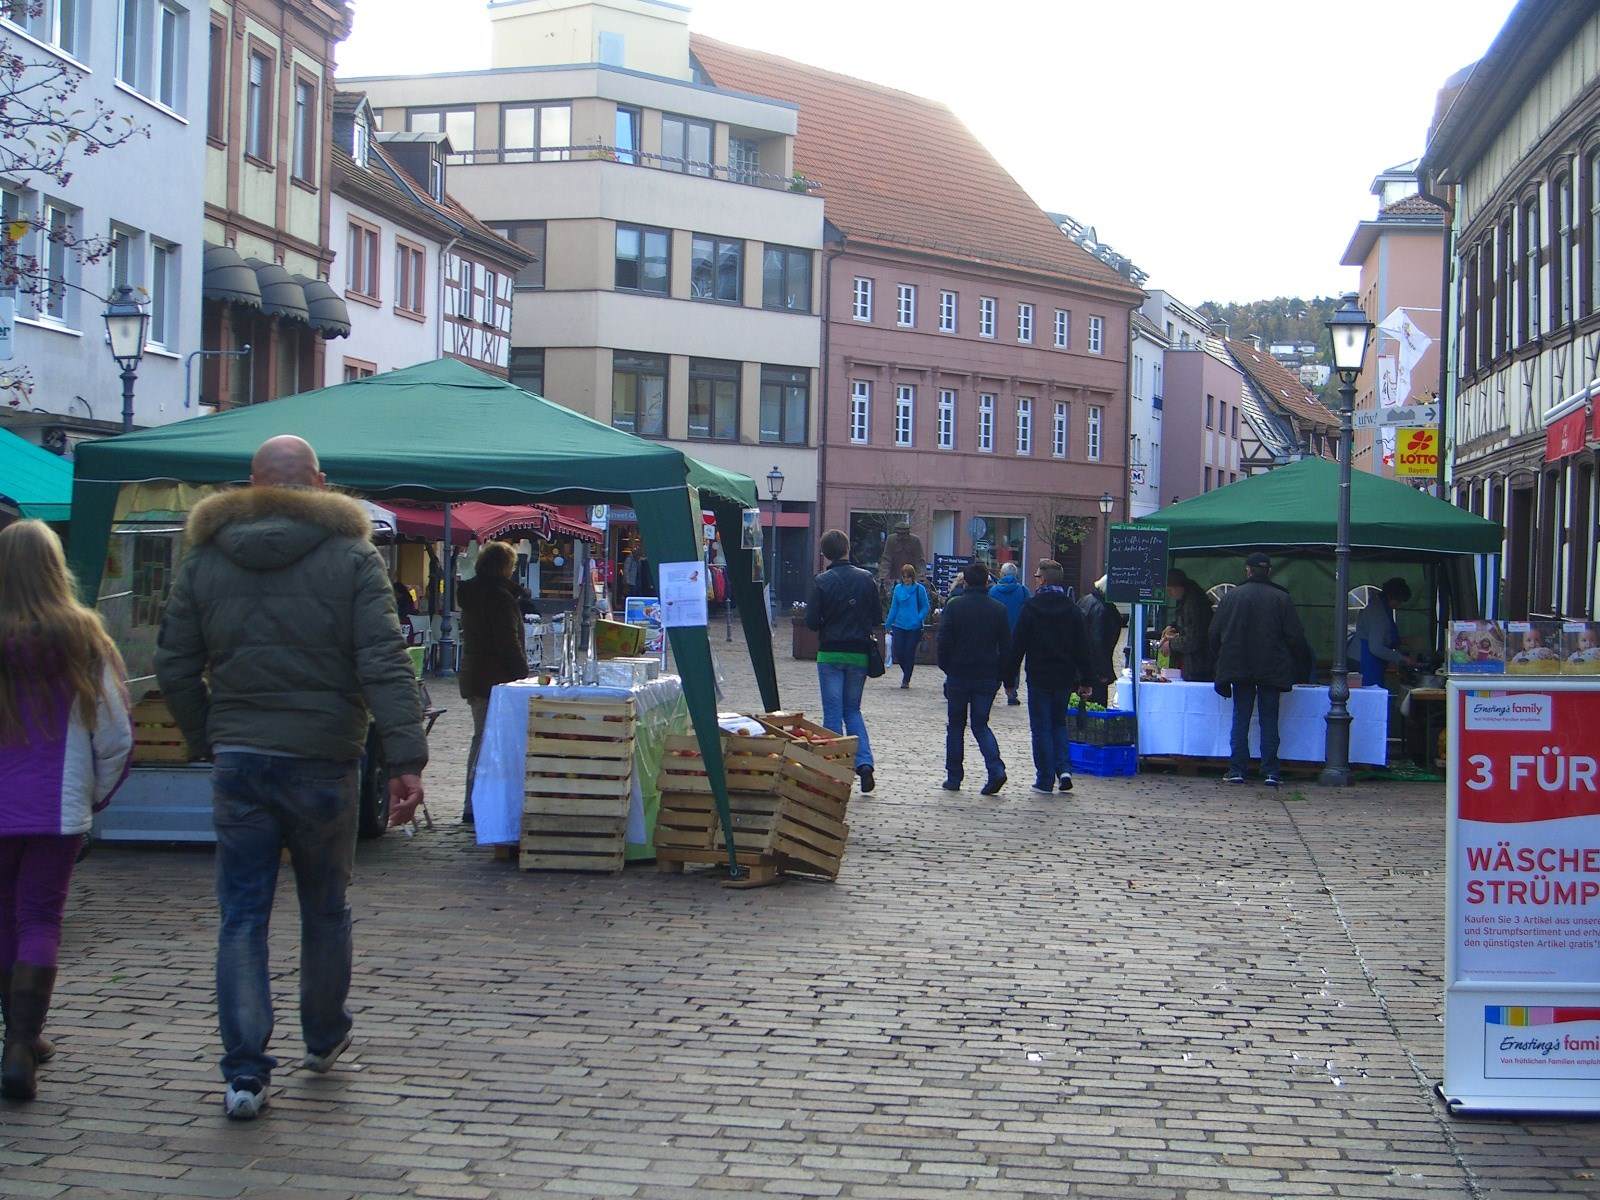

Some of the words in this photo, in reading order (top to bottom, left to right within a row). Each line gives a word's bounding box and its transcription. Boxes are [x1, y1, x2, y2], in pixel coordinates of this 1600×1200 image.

[1400, 454, 1438, 464] LOTTO
[1512, 702, 1543, 715] family
[1465, 754, 1493, 791] 3
[1509, 745, 1597, 792] FÜR
[1466, 841, 1600, 873] WÄSCHE
[1466, 874, 1600, 905] STRÜMP
[1464, 914, 1495, 924] Kaufen
[1498, 915, 1512, 924] Sie
[1514, 915, 1521, 924] 3
[1523, 916, 1552, 925] Artikel
[1464, 926, 1481, 936] und
[1483, 926, 1561, 937] Strumpfsortiment
[1564, 928, 1581, 937] und
[1463, 938, 1480, 947] den
[1483, 939, 1534, 949] günstigsten
[1536, 939, 1566, 948] Artikel
[1563, 1033, 1600, 1051] fami
[1514, 1057, 1547, 1065] fröhlichen
